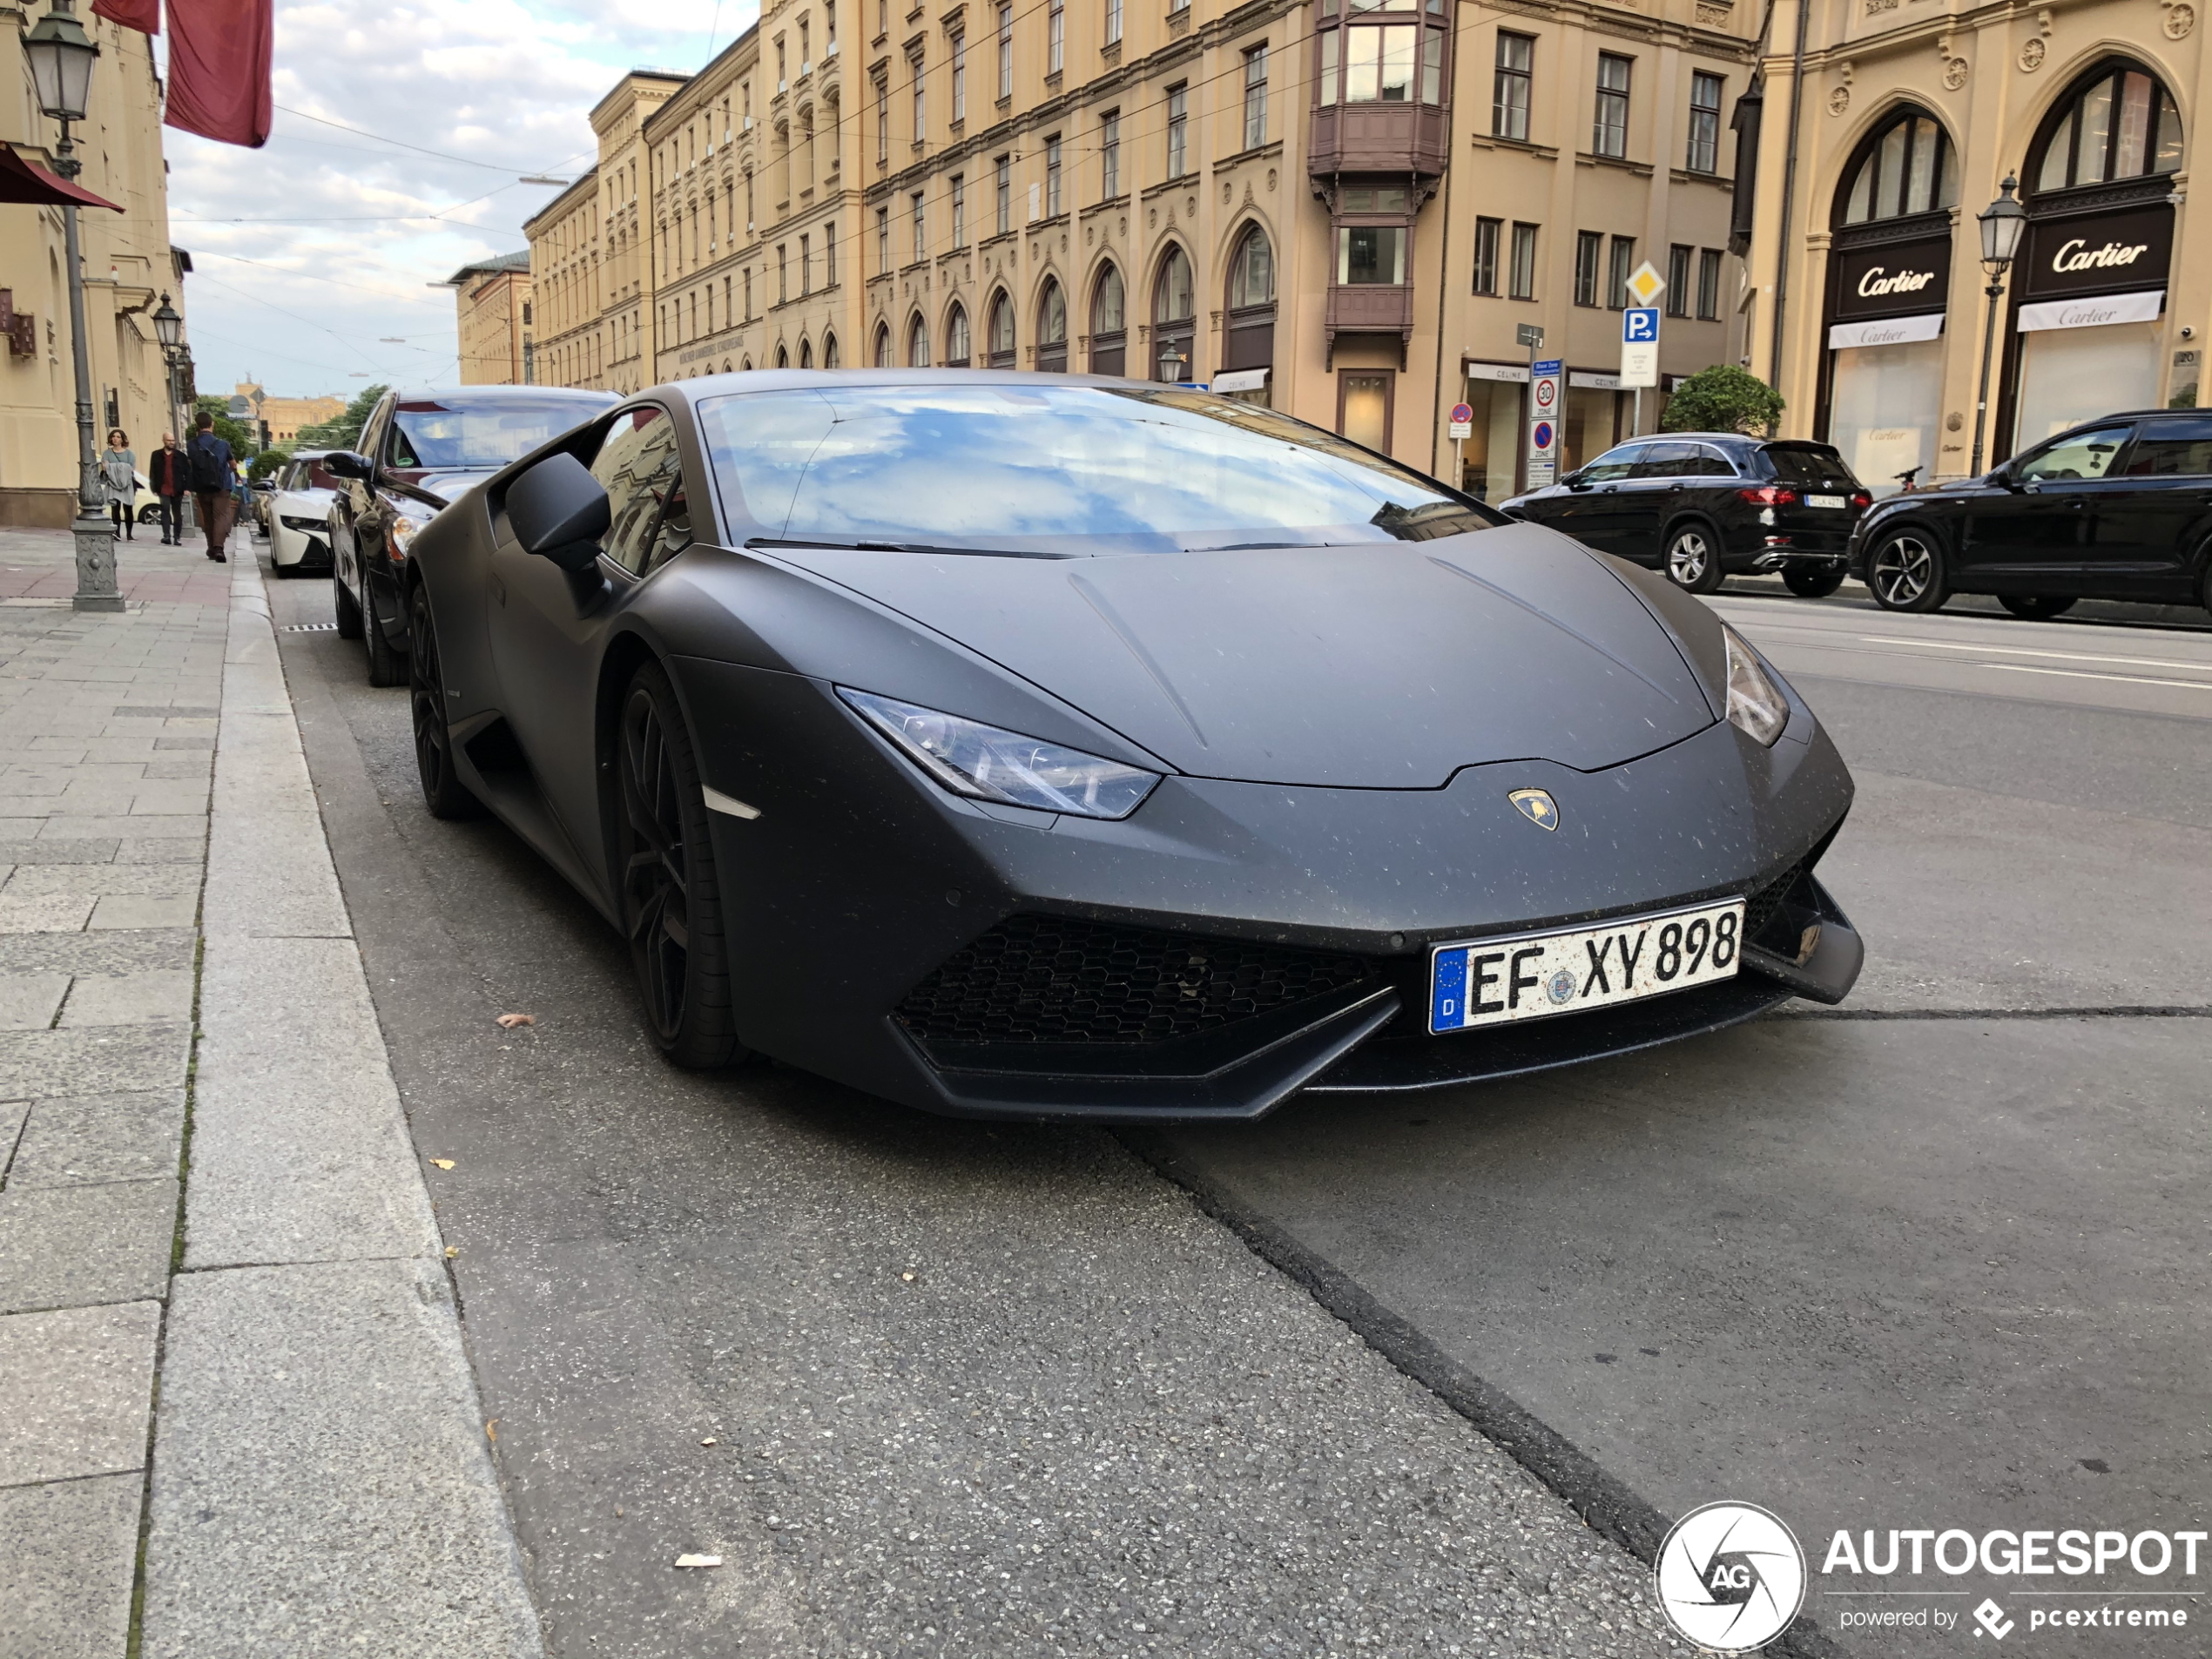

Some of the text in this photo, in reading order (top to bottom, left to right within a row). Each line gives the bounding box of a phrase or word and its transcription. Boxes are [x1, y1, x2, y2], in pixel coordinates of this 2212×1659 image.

[2052, 239, 2148, 273] Cartier
[1858, 266, 1935, 298] Cartier
[2059, 307, 2117, 326] Cartier
[1628, 313, 1649, 340] P
[1860, 326, 1907, 344] Cartier
[1496, 370, 1521, 380] CELINE
[1595, 378, 1618, 387] CELINE
[1229, 381, 1246, 389] CELINE
[1540, 387, 1551, 400] 30
[1869, 428, 1906, 441] Cartier
[1442, 998, 1454, 1016] D
[1471, 947, 1545, 1015] EF
[1581, 930, 1646, 998] XY
[1656, 911, 1737, 981] 898
